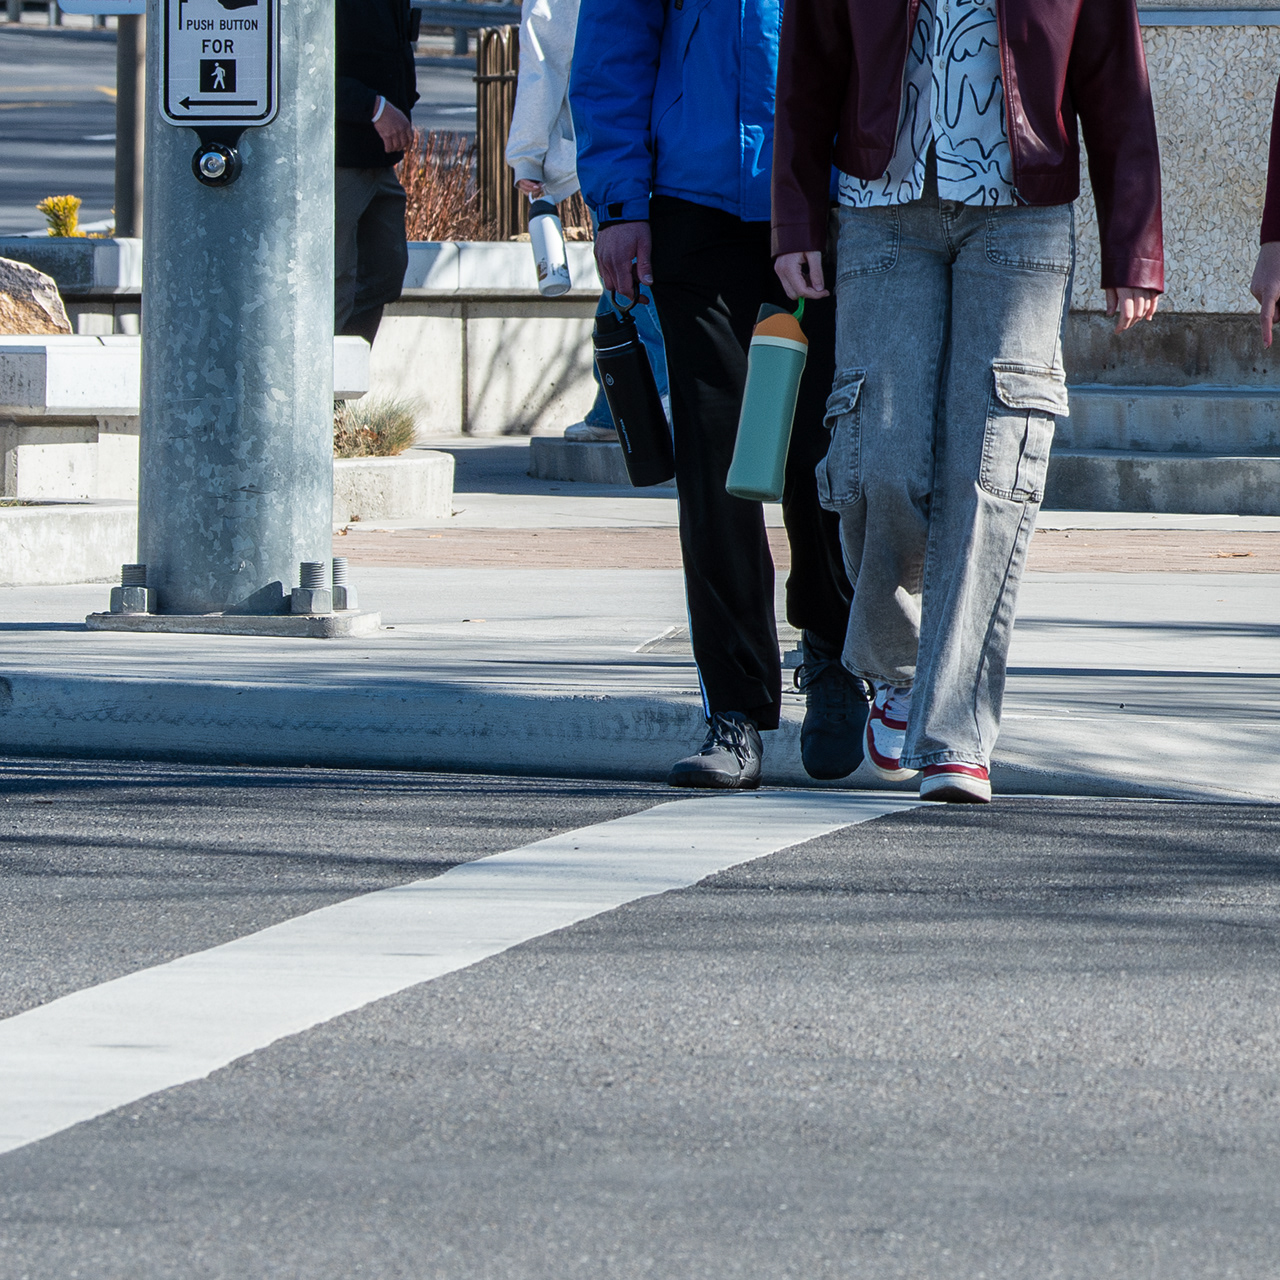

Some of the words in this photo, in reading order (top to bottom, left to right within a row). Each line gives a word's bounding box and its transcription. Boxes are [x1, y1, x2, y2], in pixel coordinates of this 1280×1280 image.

[187, 19, 214, 31] PUSH
[219, 19, 258, 31] BUTTON
[202, 39, 234, 54] FOR
